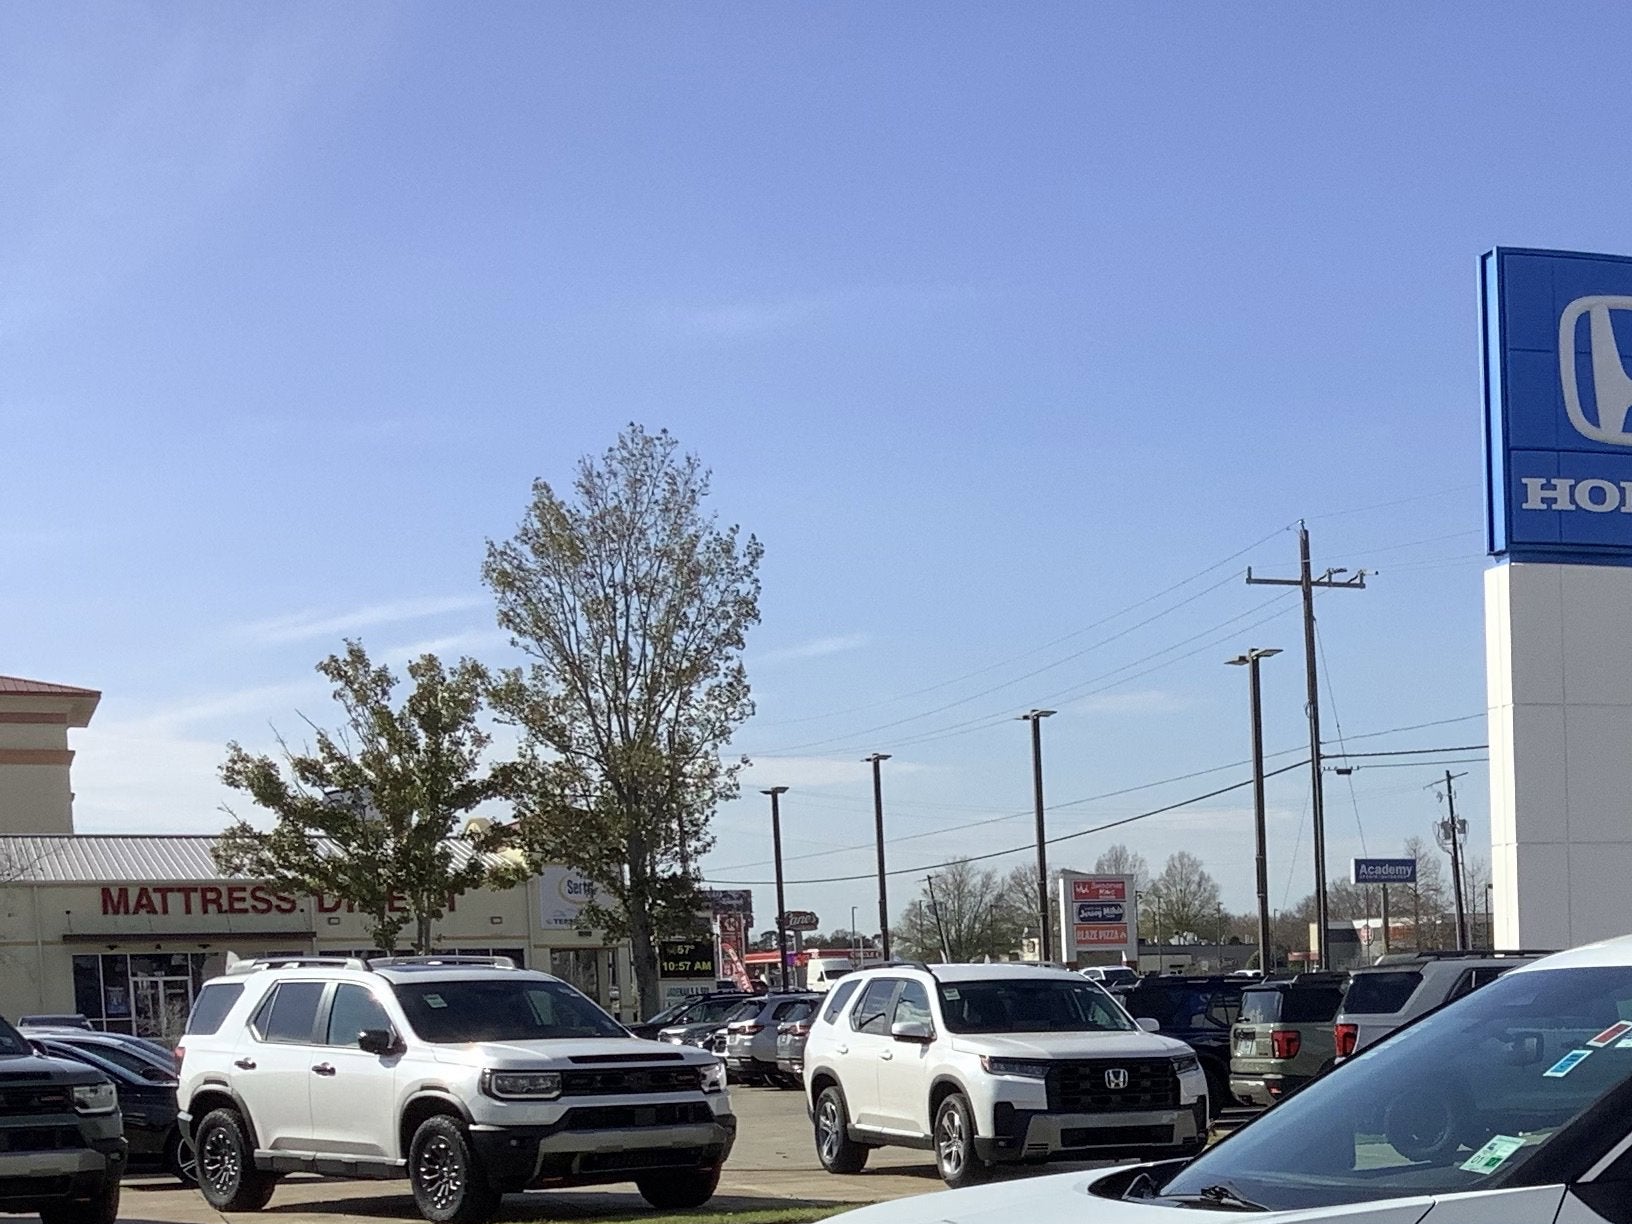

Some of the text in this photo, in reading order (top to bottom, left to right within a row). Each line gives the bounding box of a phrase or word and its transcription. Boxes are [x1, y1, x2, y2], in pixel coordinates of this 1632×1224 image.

[1360, 864, 1412, 877] Academy
[101, 887, 297, 914] MATTRESS
[662, 961, 691, 971] 10:57
[693, 961, 712, 971] AM
